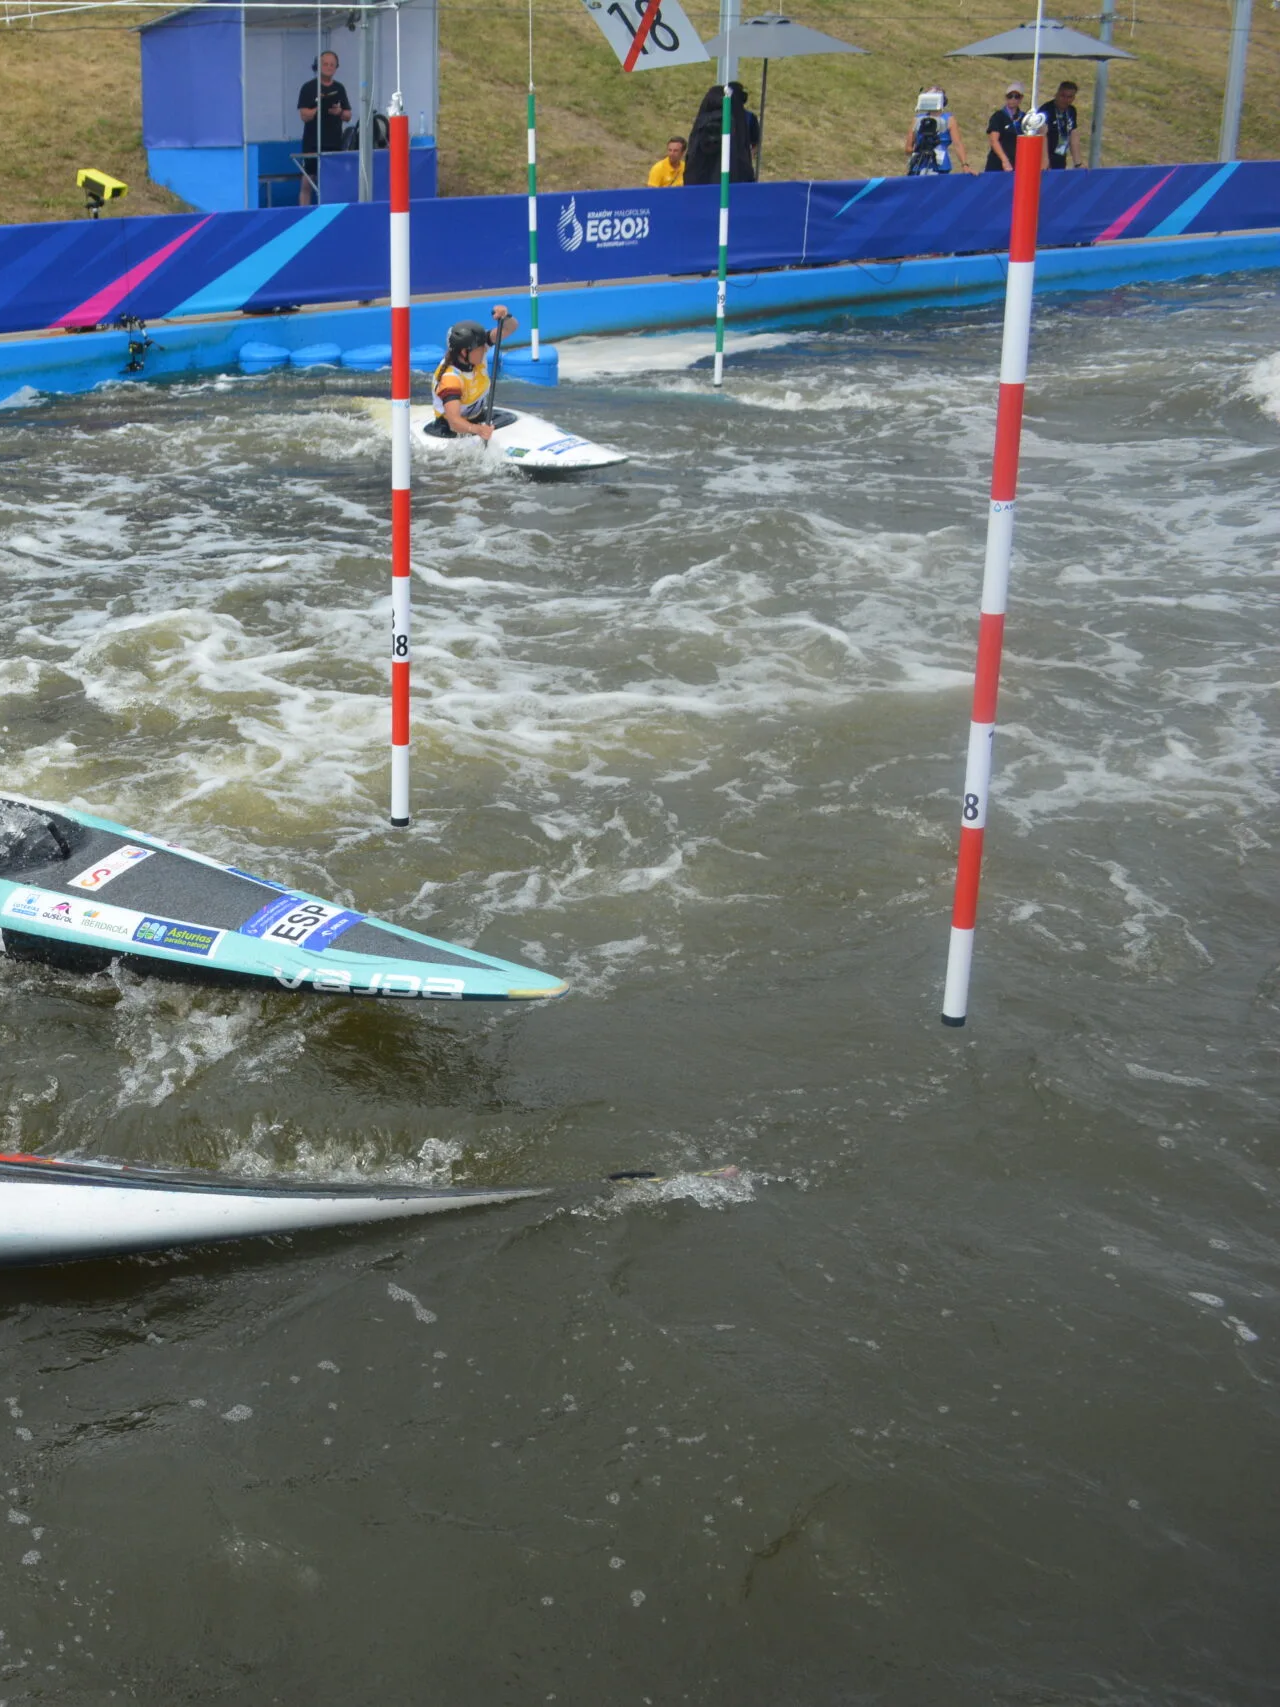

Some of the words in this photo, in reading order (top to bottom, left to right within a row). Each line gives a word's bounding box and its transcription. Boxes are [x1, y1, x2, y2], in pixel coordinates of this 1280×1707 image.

[607, 0, 679, 55] 18
[586, 217, 650, 242] EG2023
[80, 918, 128, 935] IBERDROLA
[271, 904, 328, 941] ESP
[167, 927, 213, 944] Asturias
